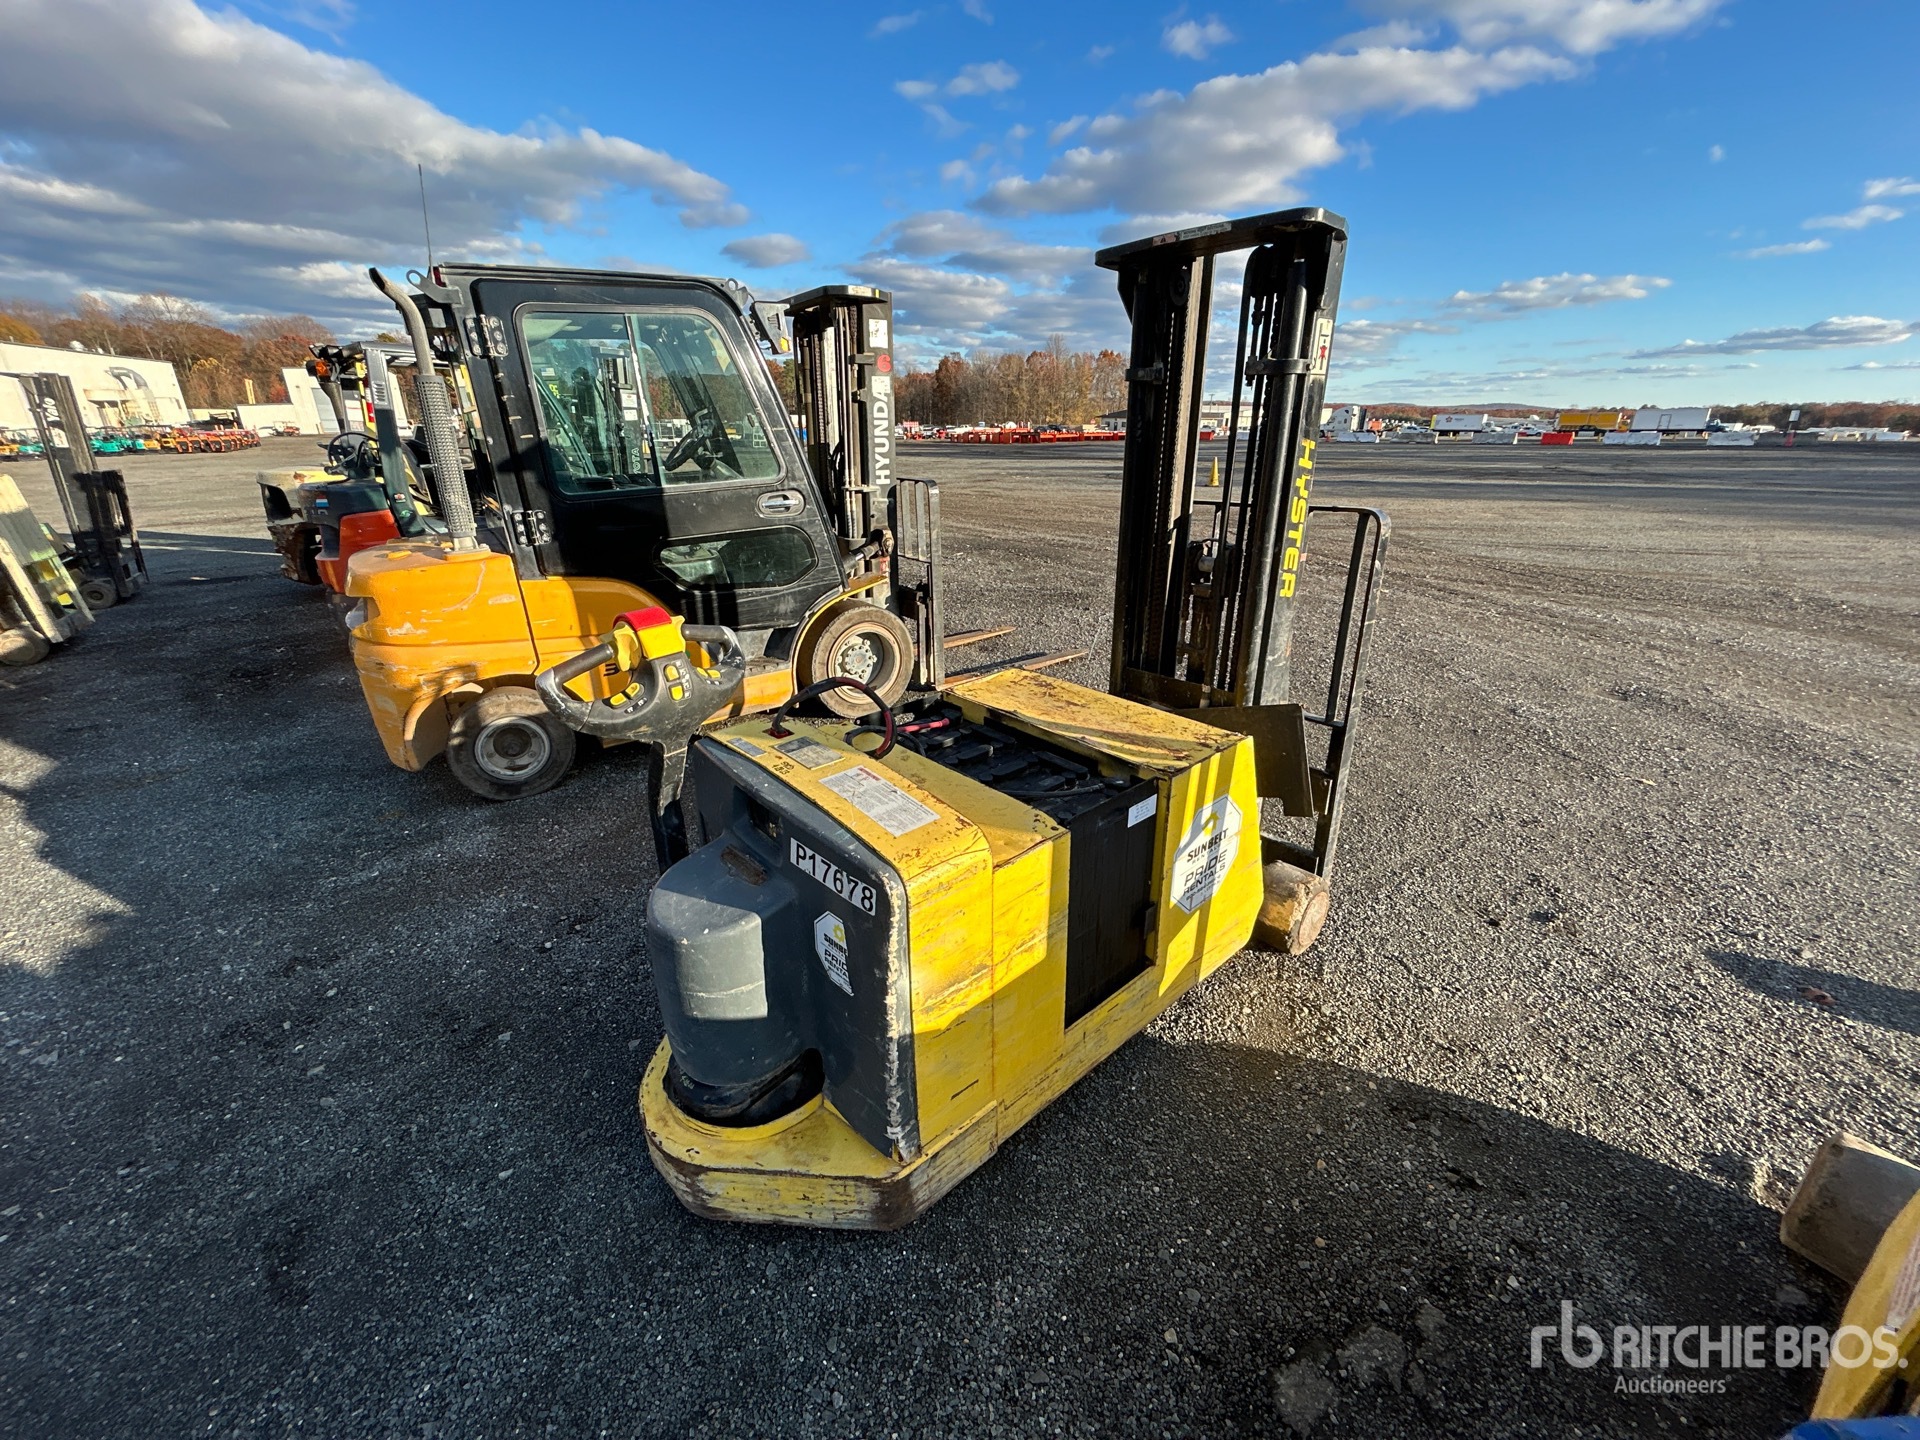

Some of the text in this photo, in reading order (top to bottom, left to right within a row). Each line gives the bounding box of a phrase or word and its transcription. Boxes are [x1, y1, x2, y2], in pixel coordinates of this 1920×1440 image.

[876, 354, 892, 373] 6
[872, 388, 892, 485] HYUNDA
[631, 447, 641, 474] YOTA
[1280, 440, 1316, 597] HYSTER
[1187, 827, 1229, 863] SUNBELT
[796, 843, 874, 912] P17678
[1183, 862, 1226, 896] RENTALS
[1184, 848, 1228, 887] PRIDE
[824, 934, 849, 957] SUNBE
[824, 949, 848, 972] PRID
[824, 957, 849, 978] RENTA
